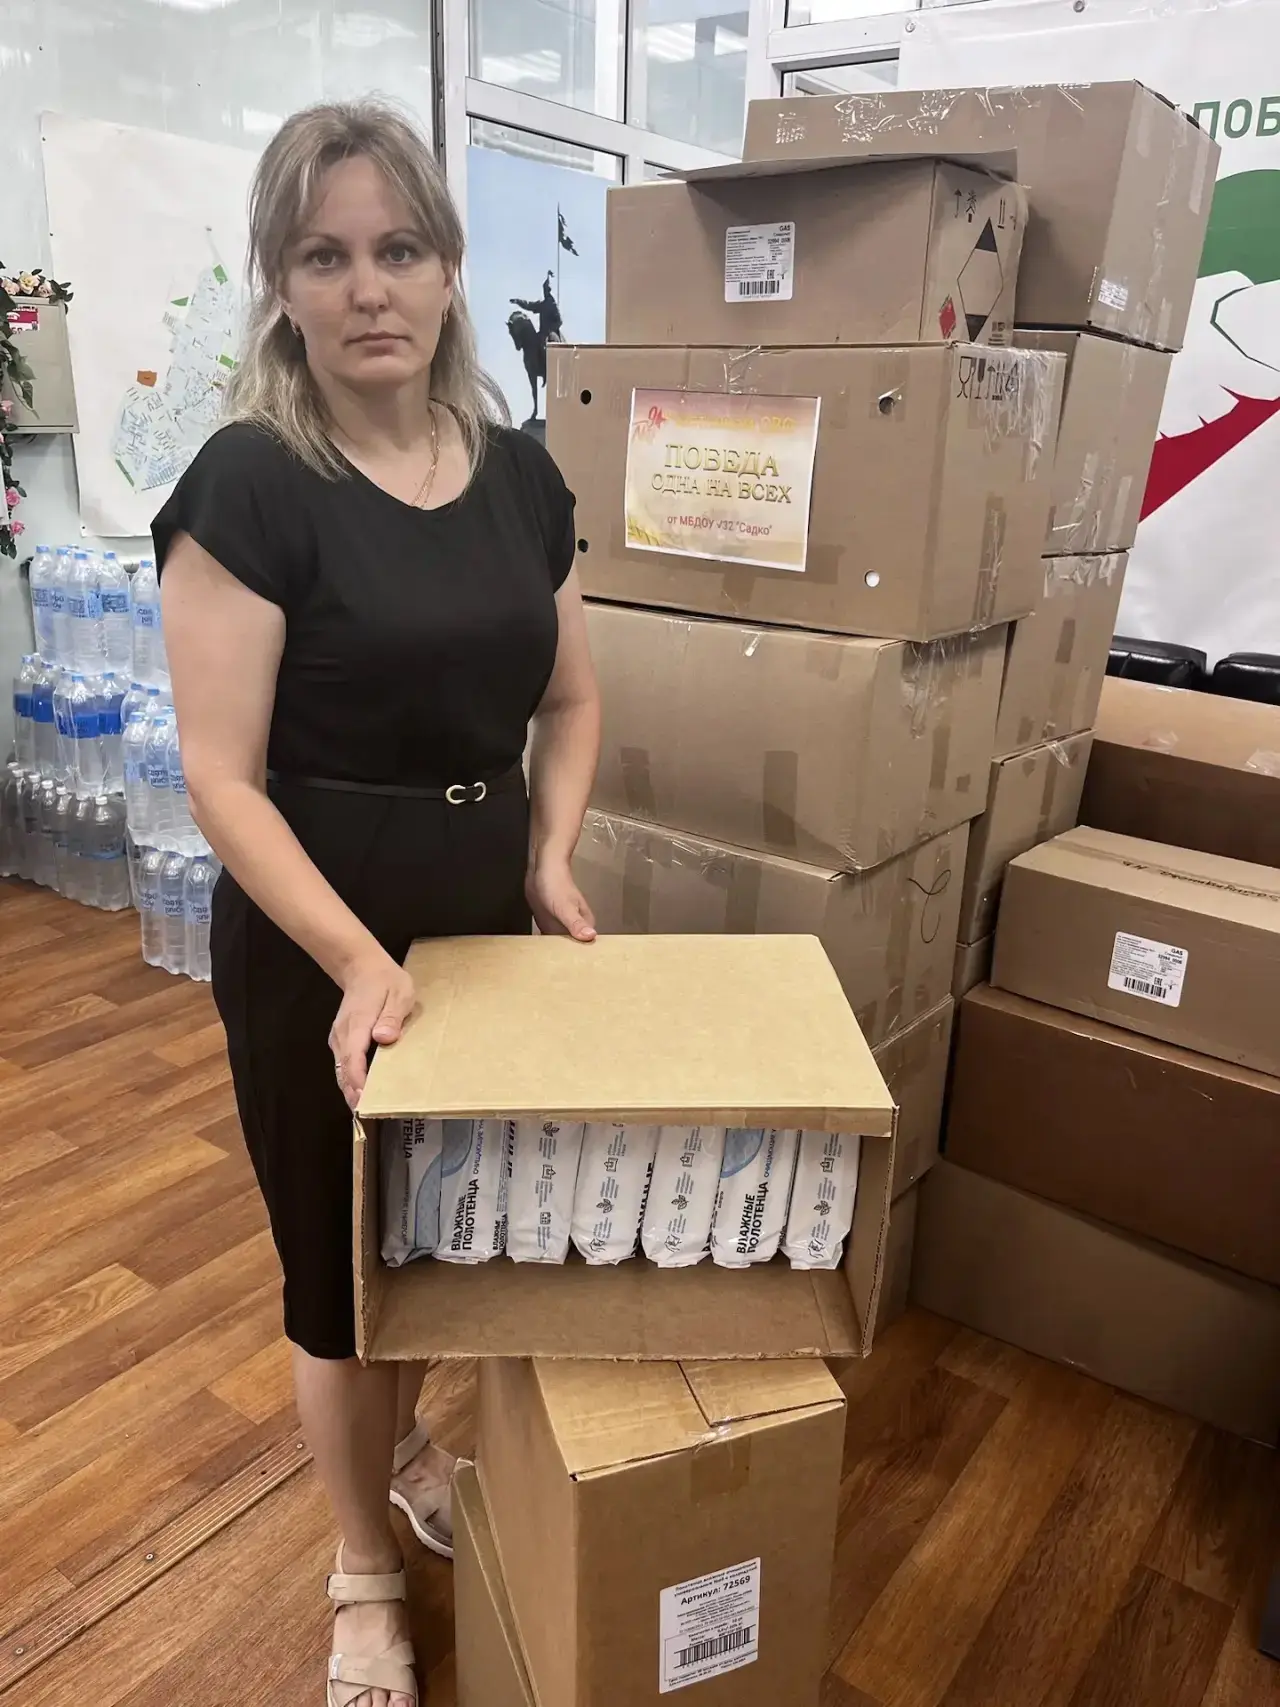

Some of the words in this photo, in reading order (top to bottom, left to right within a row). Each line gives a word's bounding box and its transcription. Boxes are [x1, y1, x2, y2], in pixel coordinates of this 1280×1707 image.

[664, 444, 780, 480] ПОБЕДА
[651, 473, 701, 495] ОДНА
[706, 478, 732, 498] НА
[738, 482, 792, 504] ВСЕХ
[667, 516, 678, 524] от
[680, 516, 714, 529] МБДОУ
[1171, 948, 1183, 956] GAS
[451, 1194, 466, 1251] ВЛАЖНЫЕ
[462, 1178, 479, 1251] ПОЛОТЕНЦА
[736, 1194, 756, 1254] ВЛАЖНЫЕ
[747, 1182, 768, 1254] ПОЛОТЕНЦА
[680, 1586, 721, 1606] Артикул:
[723, 1575, 751, 1592] 72569
